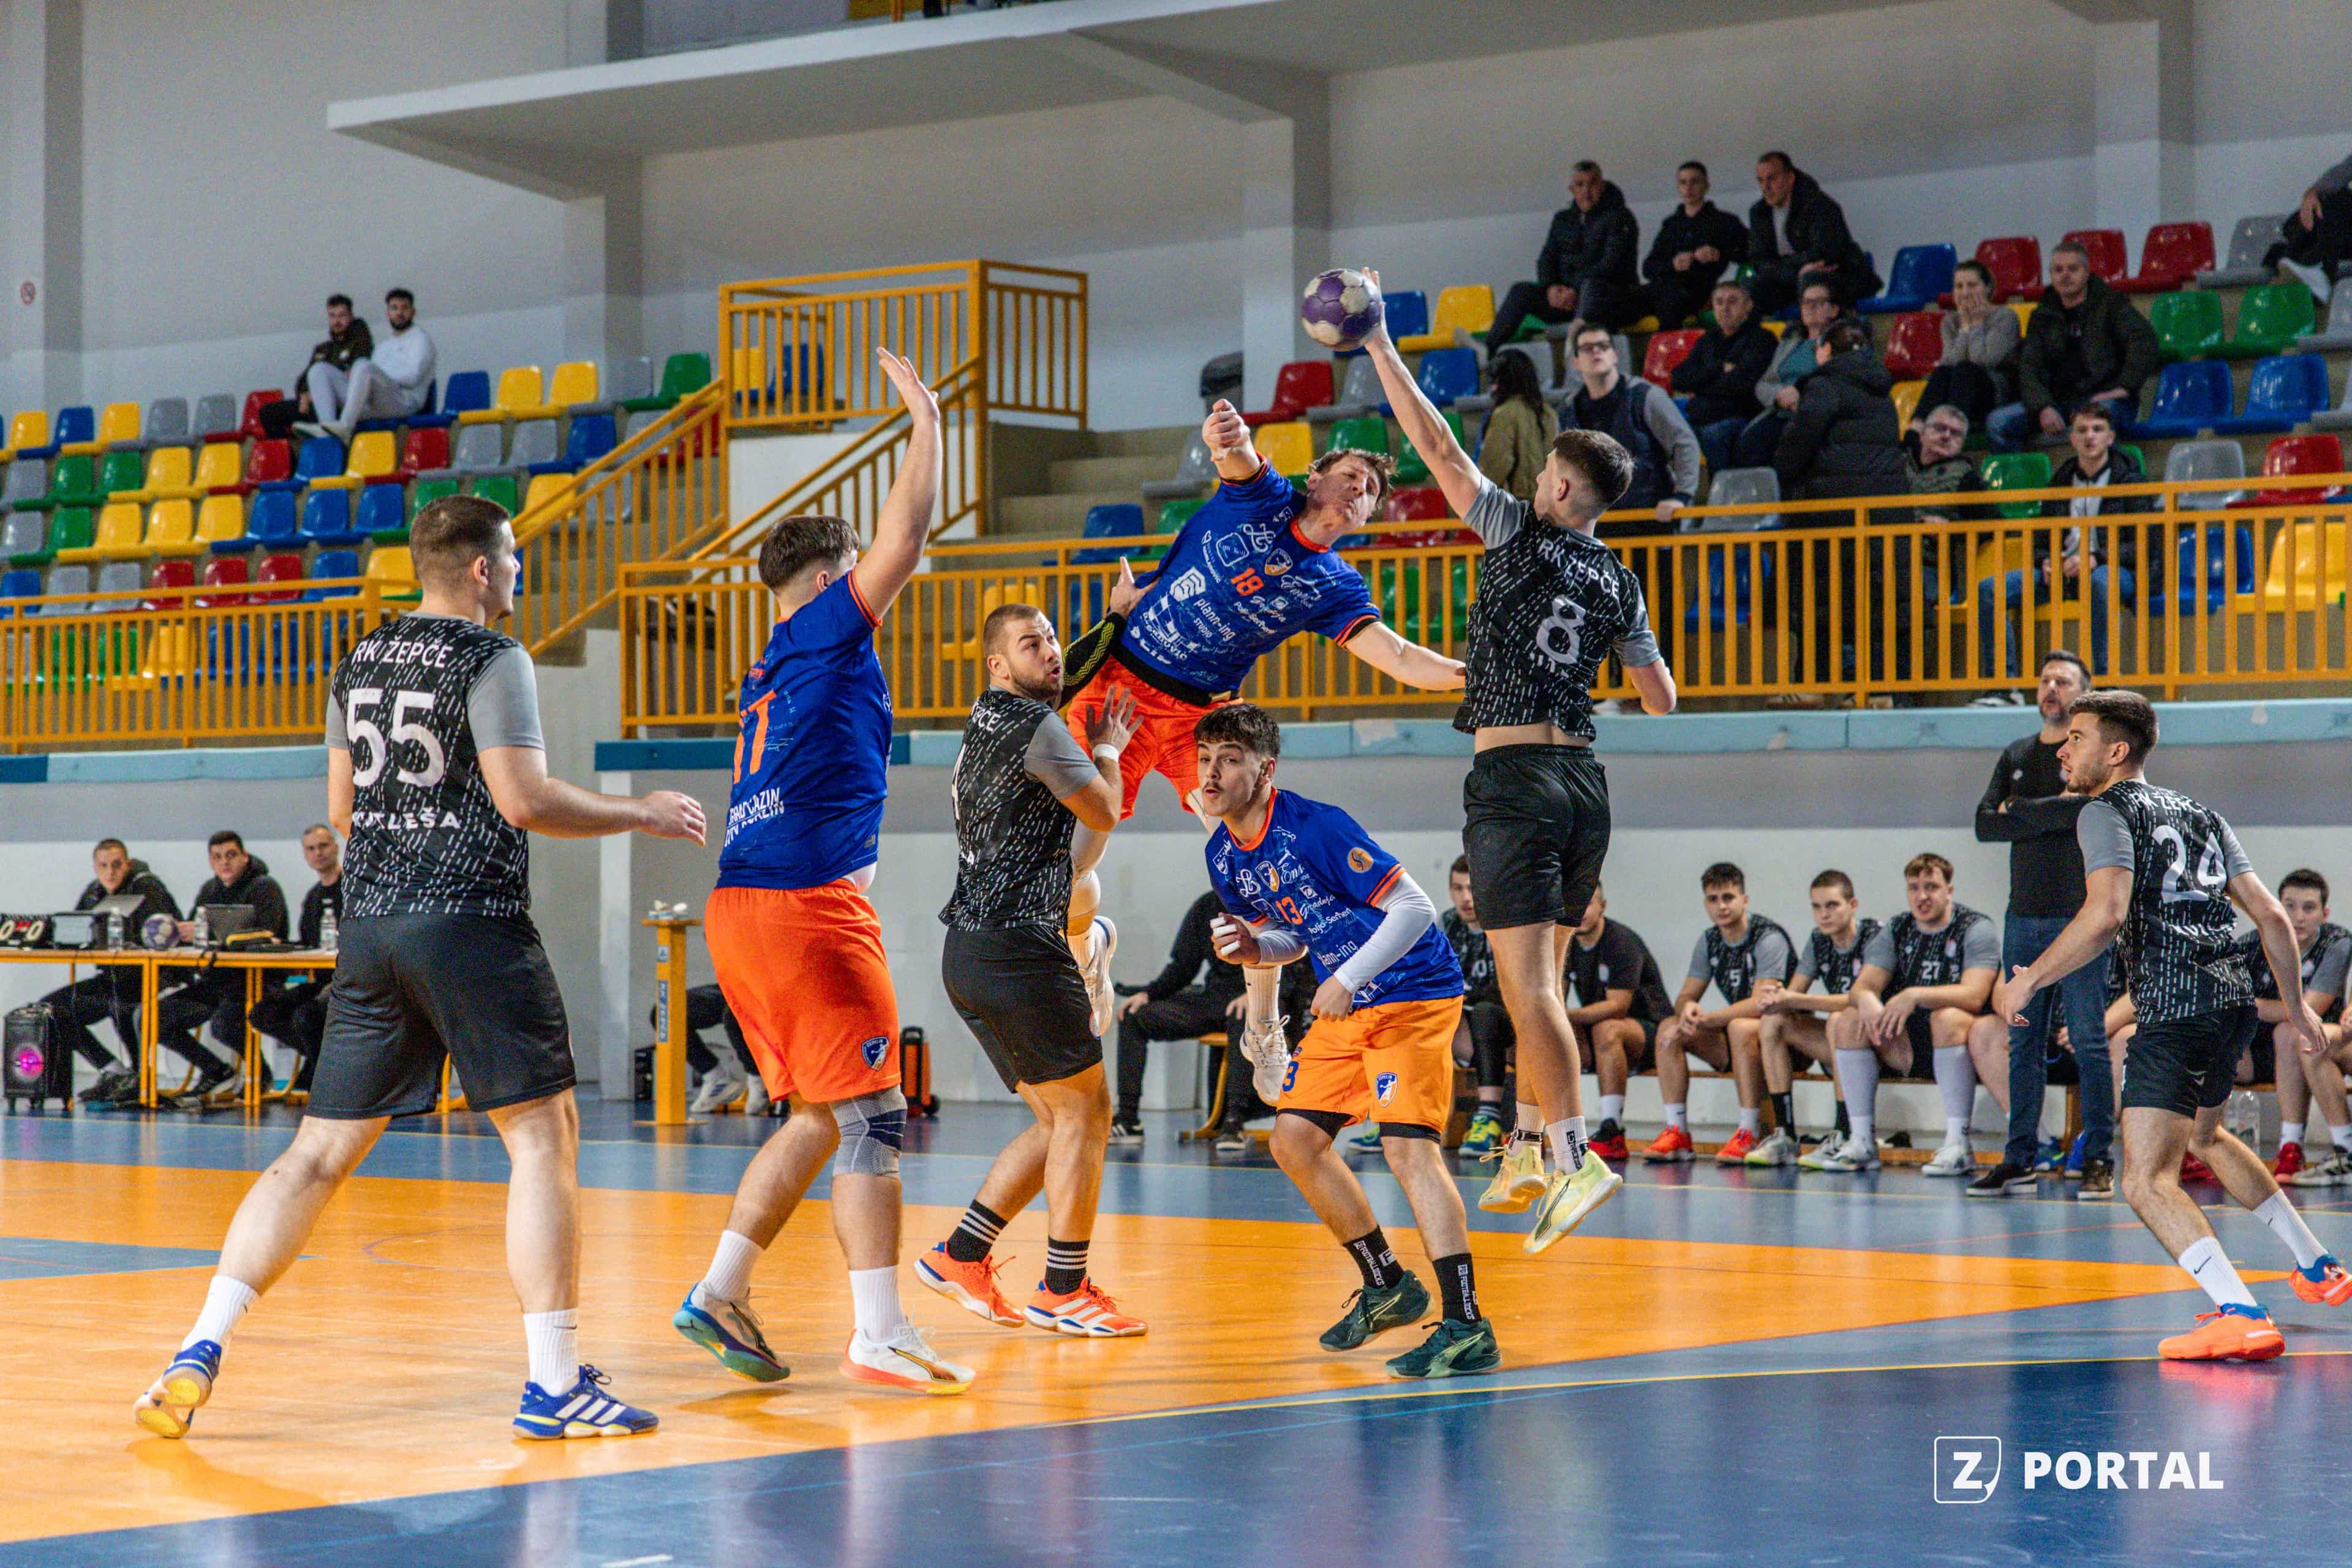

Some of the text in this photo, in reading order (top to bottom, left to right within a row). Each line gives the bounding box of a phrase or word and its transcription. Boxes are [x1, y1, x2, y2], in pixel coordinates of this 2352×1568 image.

[1538, 538, 1565, 568] RK
[1230, 567, 1264, 597] 18
[1193, 598, 1236, 641] plann-ing
[1193, 617, 1213, 638] STUDIO
[1536, 595, 1586, 665] 8
[351, 635, 453, 668] RK ŽEPČE
[347, 688, 445, 787] 55
[1275, 897, 1303, 924] 13
[1921, 962, 1941, 980] 27
